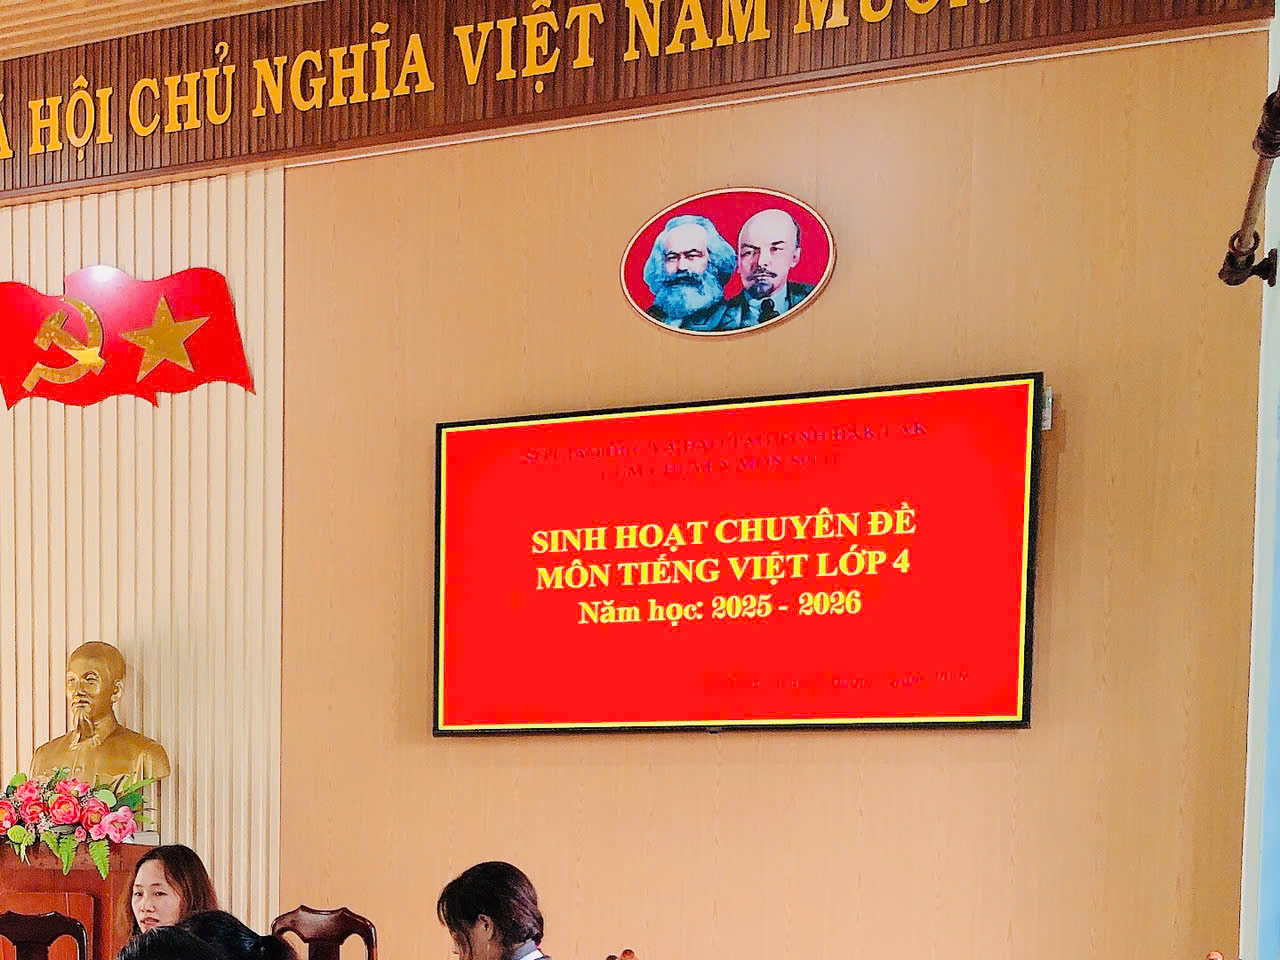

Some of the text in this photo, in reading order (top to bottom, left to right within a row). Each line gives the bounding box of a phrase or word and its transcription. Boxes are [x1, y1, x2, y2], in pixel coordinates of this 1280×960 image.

[28, 75, 113, 162] HỘI
[128, 41, 237, 137] CHỦ
[251, 22, 435, 118] NGHĨA
[452, 0, 605, 93] VIỆT
[623, 0, 771, 61] NAM
[531, 501, 917, 554] SINH HOẠT CHUYÊN ĐỀ
[535, 543, 911, 590] MÔN TIẾNG VIỆT LỚP 4
[577, 599, 641, 625] Năm
[647, 598, 704, 627] học:
[711, 593, 773, 620] 2025
[798, 589, 862, 616] 2026
